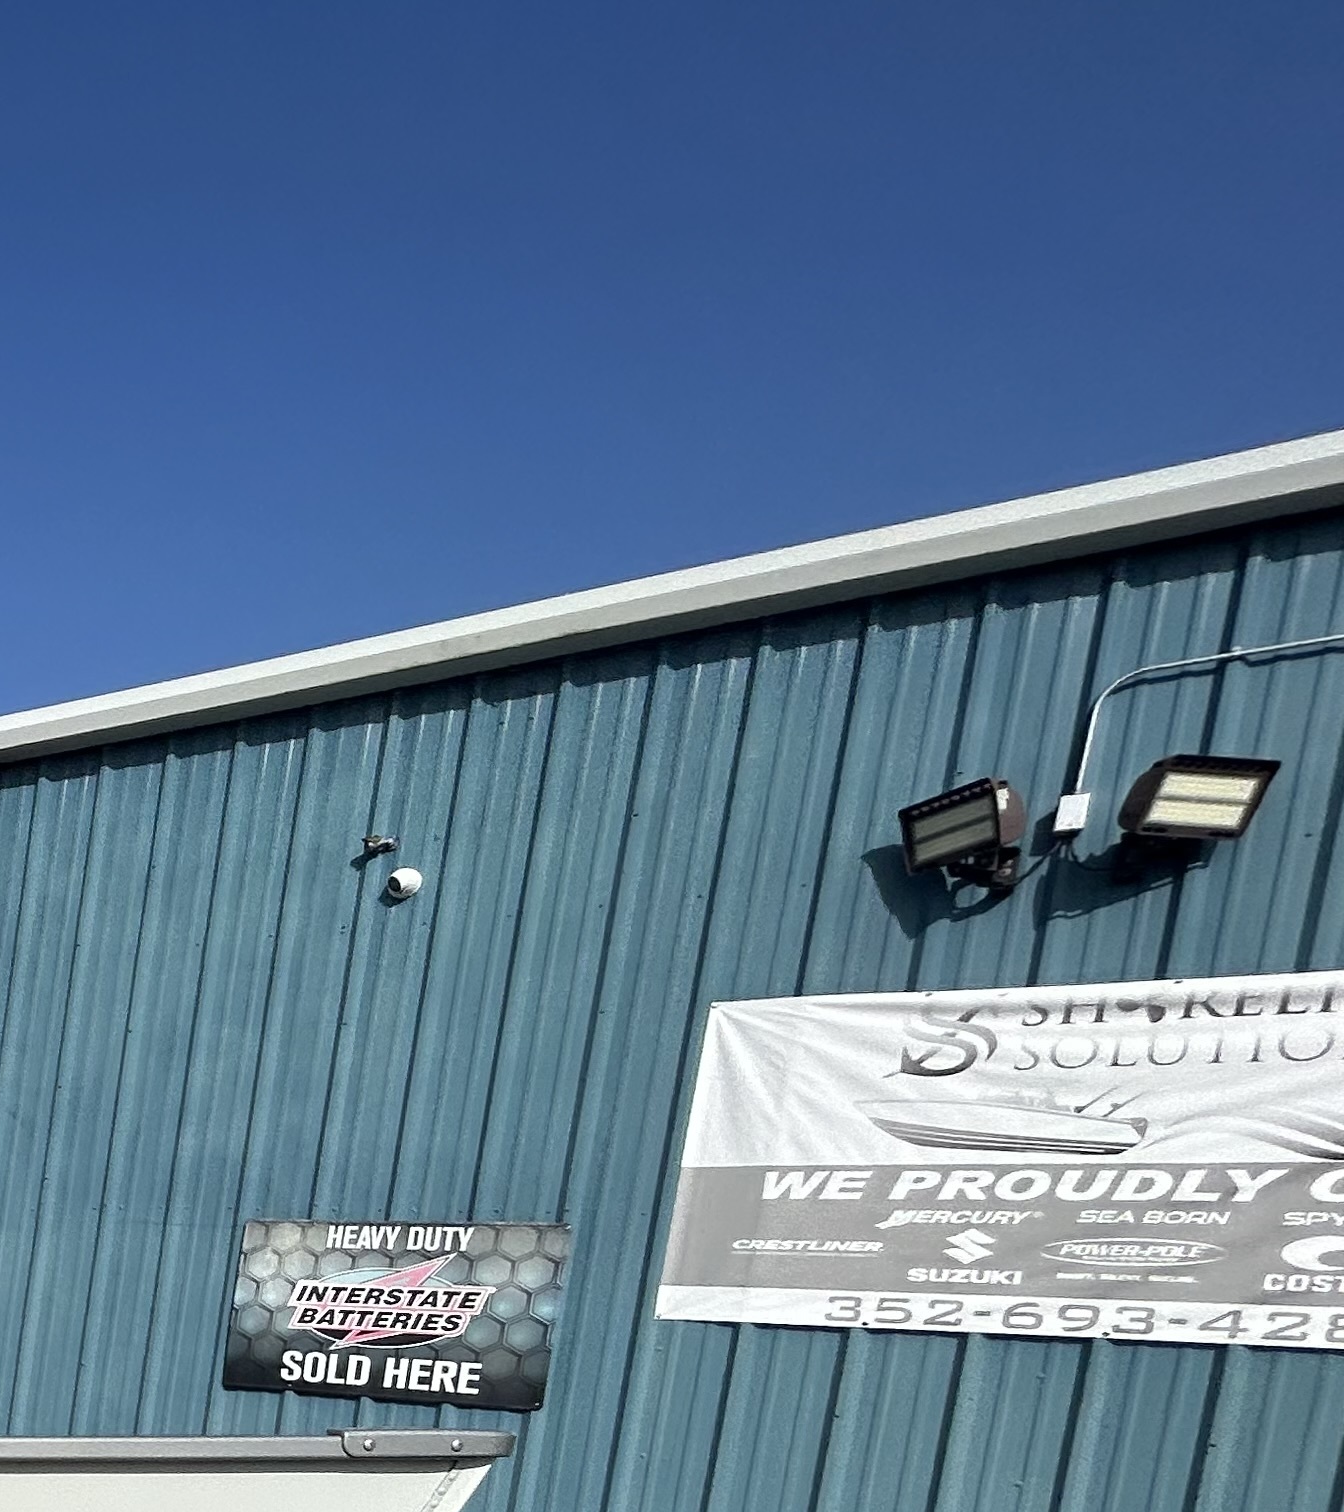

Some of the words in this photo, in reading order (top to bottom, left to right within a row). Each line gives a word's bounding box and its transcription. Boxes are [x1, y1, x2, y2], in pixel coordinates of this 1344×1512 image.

[762, 1170, 874, 1201] WE
[888, 1168, 1292, 1203] PROUDLY
[874, 1209, 1034, 1230] MERCURY
[1076, 1209, 1135, 1225] SEA
[1142, 1209, 1232, 1226] BORN
[326, 1225, 402, 1251] HEAVY
[405, 1226, 475, 1252] DUTY
[732, 1238, 885, 1252] CRESTLINER
[906, 1267, 1023, 1286] SUZUKI
[296, 1284, 482, 1310] INTERSTATE
[297, 1308, 464, 1332] BATTERIES
[280, 1350, 371, 1387] SOLD
[383, 1357, 483, 1395] HERE
